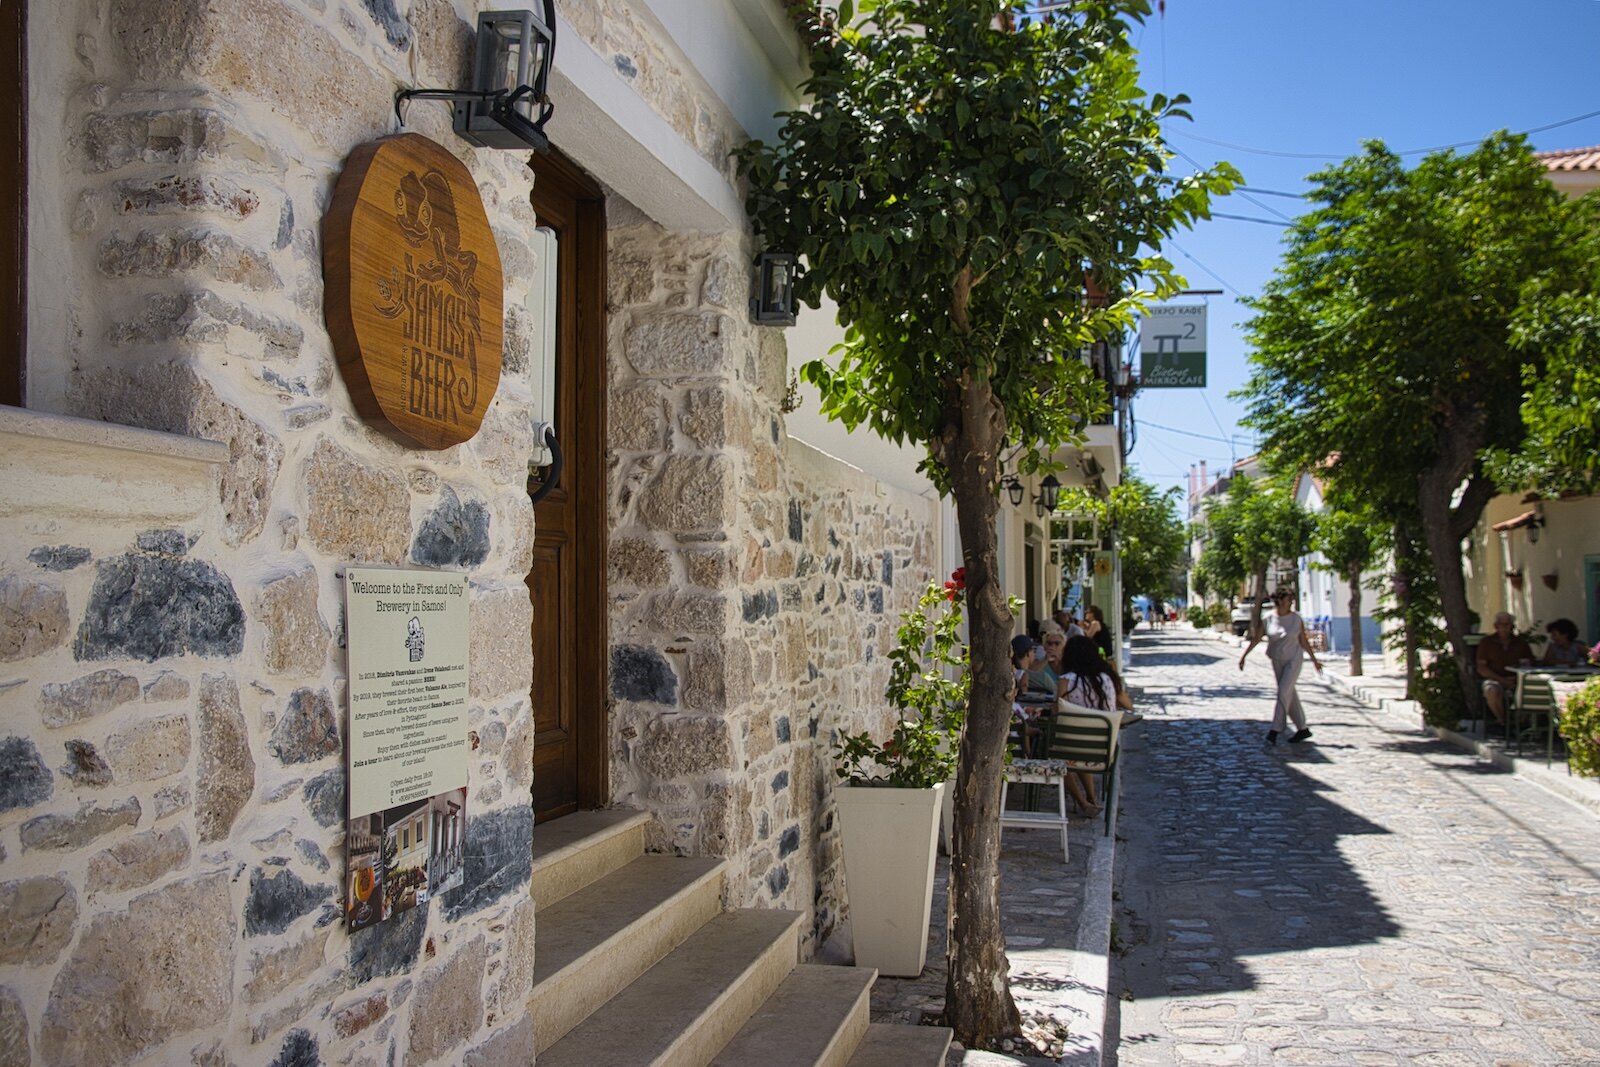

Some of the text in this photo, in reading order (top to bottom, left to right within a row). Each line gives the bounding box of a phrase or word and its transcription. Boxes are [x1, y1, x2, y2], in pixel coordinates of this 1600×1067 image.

[402, 274, 467, 360] SAMOS
[410, 347, 459, 425] BEER
[352, 582, 463, 596] Welcome to the First and Only
[376, 600, 446, 614] Brewery in Samos!
[377, 670, 394, 678] Dimitris
[372, 691, 381, 700] they
[367, 711, 378, 720] years
[419, 703, 430, 711] opened
[377, 746, 388, 755] Enjoy
[412, 747, 426, 756] brewing
[454, 739, 465, 747] history
[404, 776, 413, 785] daily
